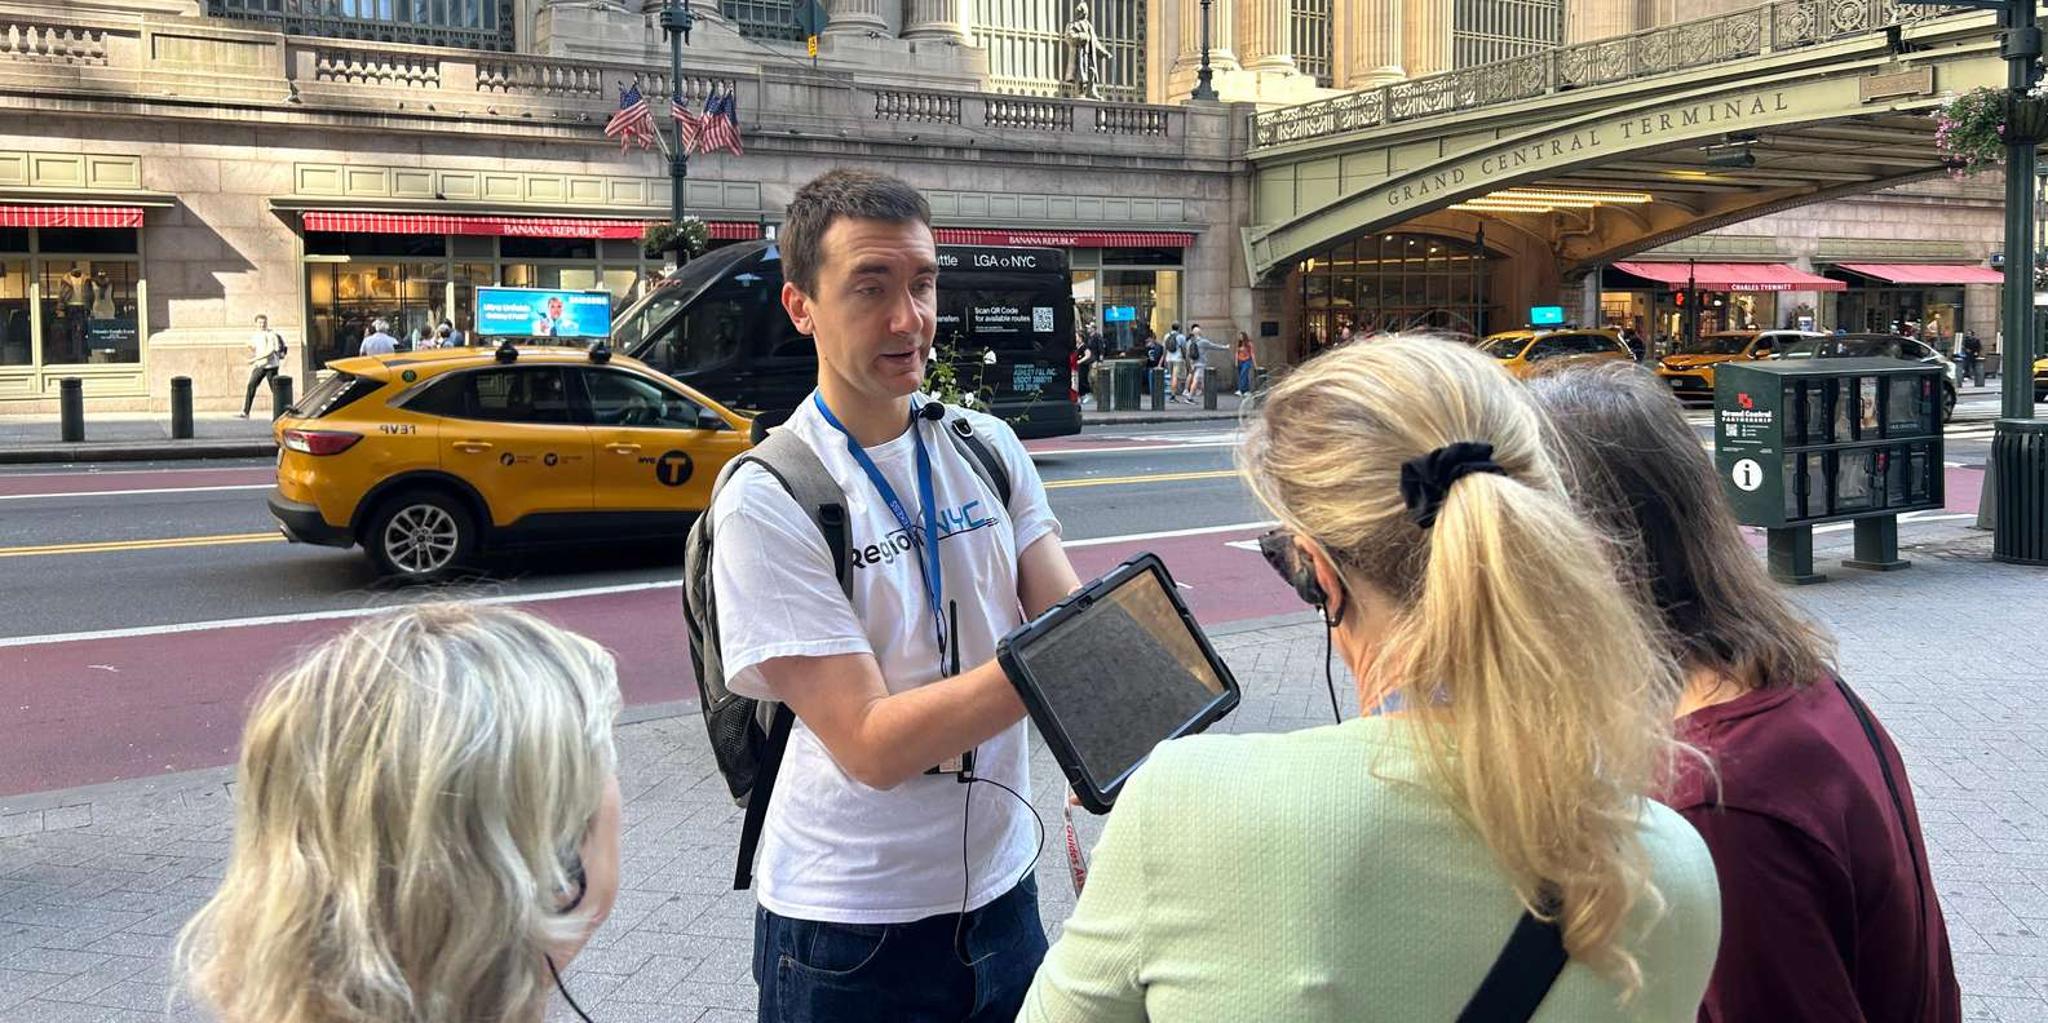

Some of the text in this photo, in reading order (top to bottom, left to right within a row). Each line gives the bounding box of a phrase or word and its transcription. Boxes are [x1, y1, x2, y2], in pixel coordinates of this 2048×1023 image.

[1387, 92, 1788, 206] GRAND CENTRAL TERMINAL
[503, 224, 604, 237] BANANA REPUBLIC
[1008, 236, 1079, 246] BANANA REPUBLIC
[973, 254, 1037, 268] LGA NYC
[974, 306, 1019, 315] Scan QR Code
[1011, 315, 1031, 323] routes
[1721, 409, 1773, 418] Grand Central
